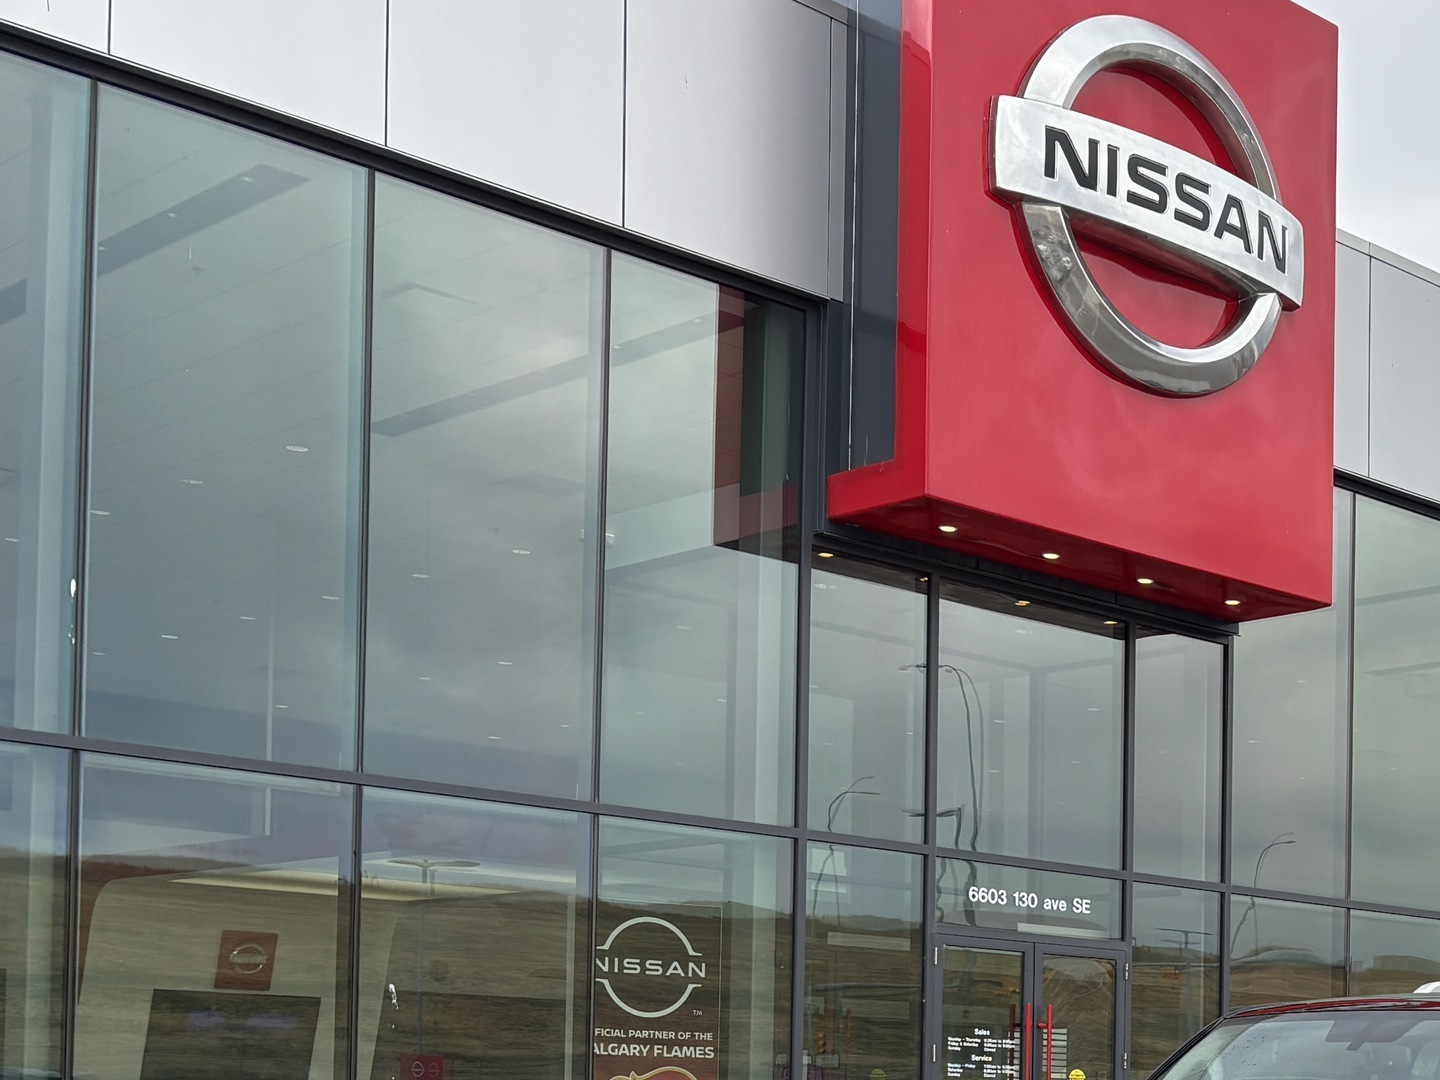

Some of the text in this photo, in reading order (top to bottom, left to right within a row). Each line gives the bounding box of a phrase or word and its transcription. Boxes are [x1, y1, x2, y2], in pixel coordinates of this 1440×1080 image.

[1044, 125, 1288, 274] NISSAN
[968, 886, 1091, 914] 6603 130 ave SE
[595, 956, 706, 978] NISSAN
[628, 1029, 675, 1040] PARTNER
[677, 1031, 692, 1040] OF
[694, 1032, 713, 1041] THE
[653, 1045, 715, 1059] FLAMES
